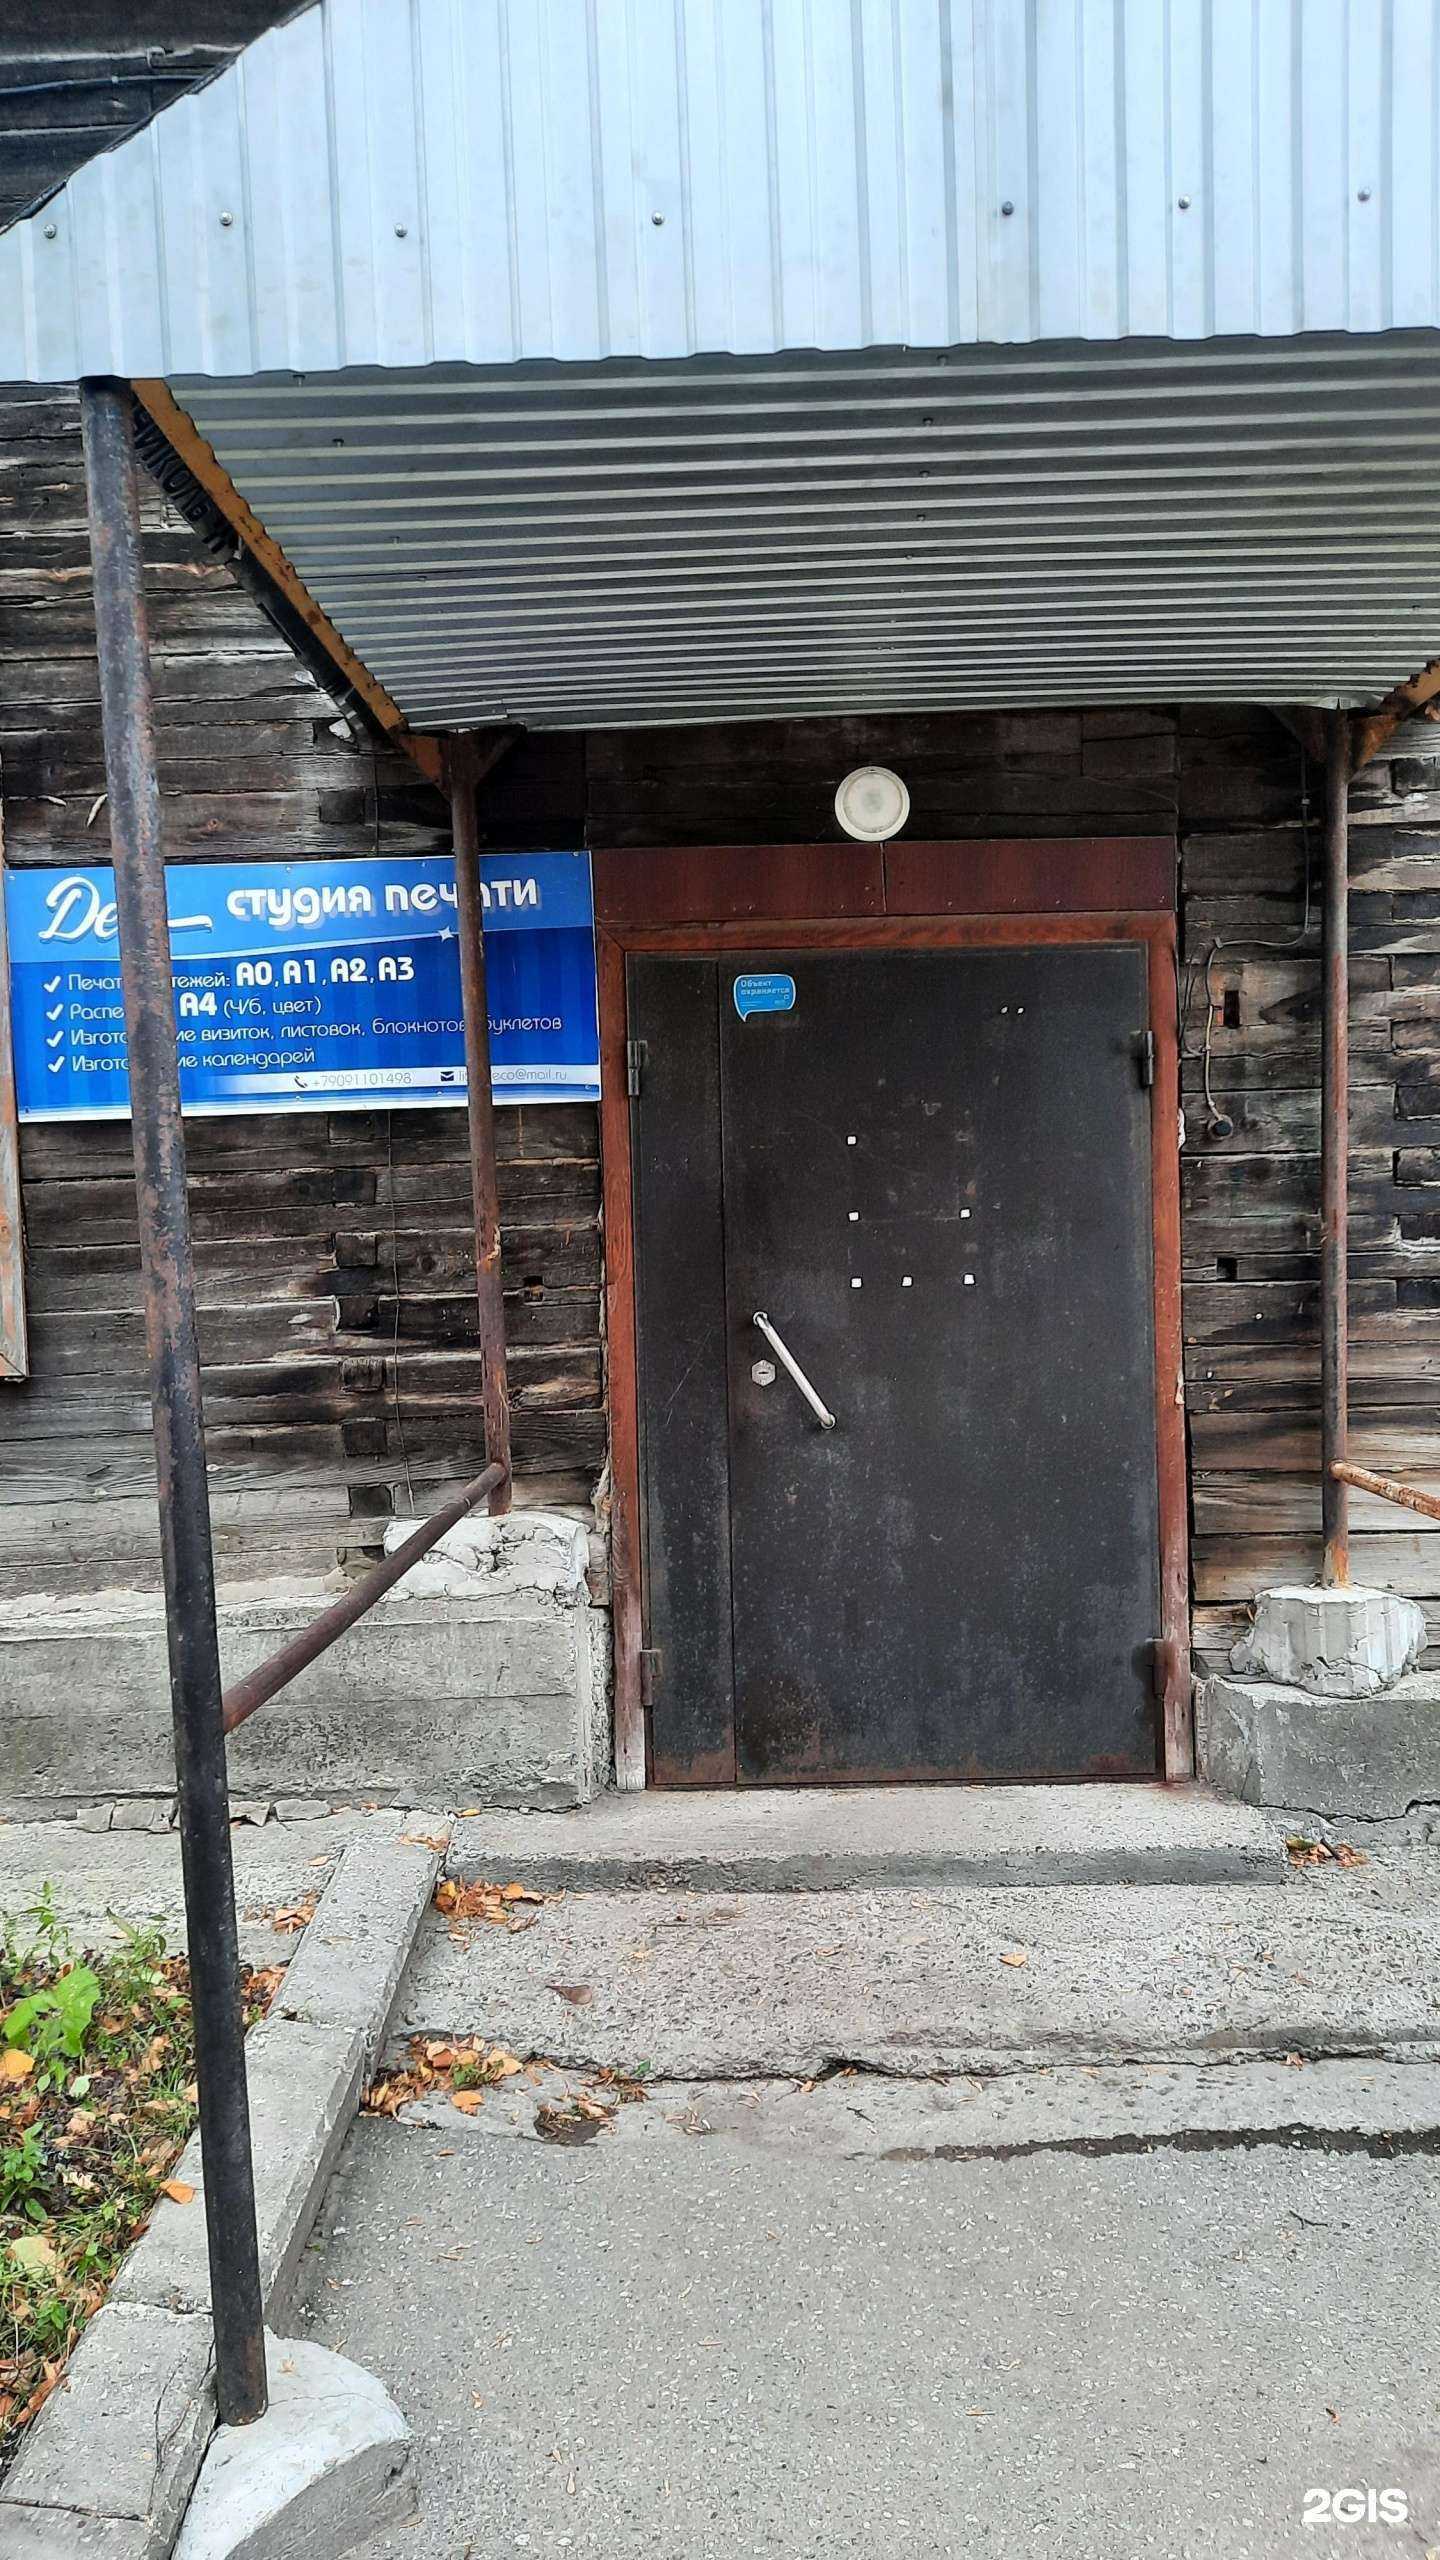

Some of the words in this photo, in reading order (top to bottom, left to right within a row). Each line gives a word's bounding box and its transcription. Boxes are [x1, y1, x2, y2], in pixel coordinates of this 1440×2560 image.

[226, 884, 372, 926] студия
[378, 956, 415, 981] А3
[180, 991, 217, 1017] А4
[272, 995, 322, 1015] цвет)
[202, 1027, 274, 1043] визиток,
[281, 1022, 365, 1039] листовок,
[202, 1048, 315, 1069] календарей
[312, 1072, 412, 1088] +79091101498
